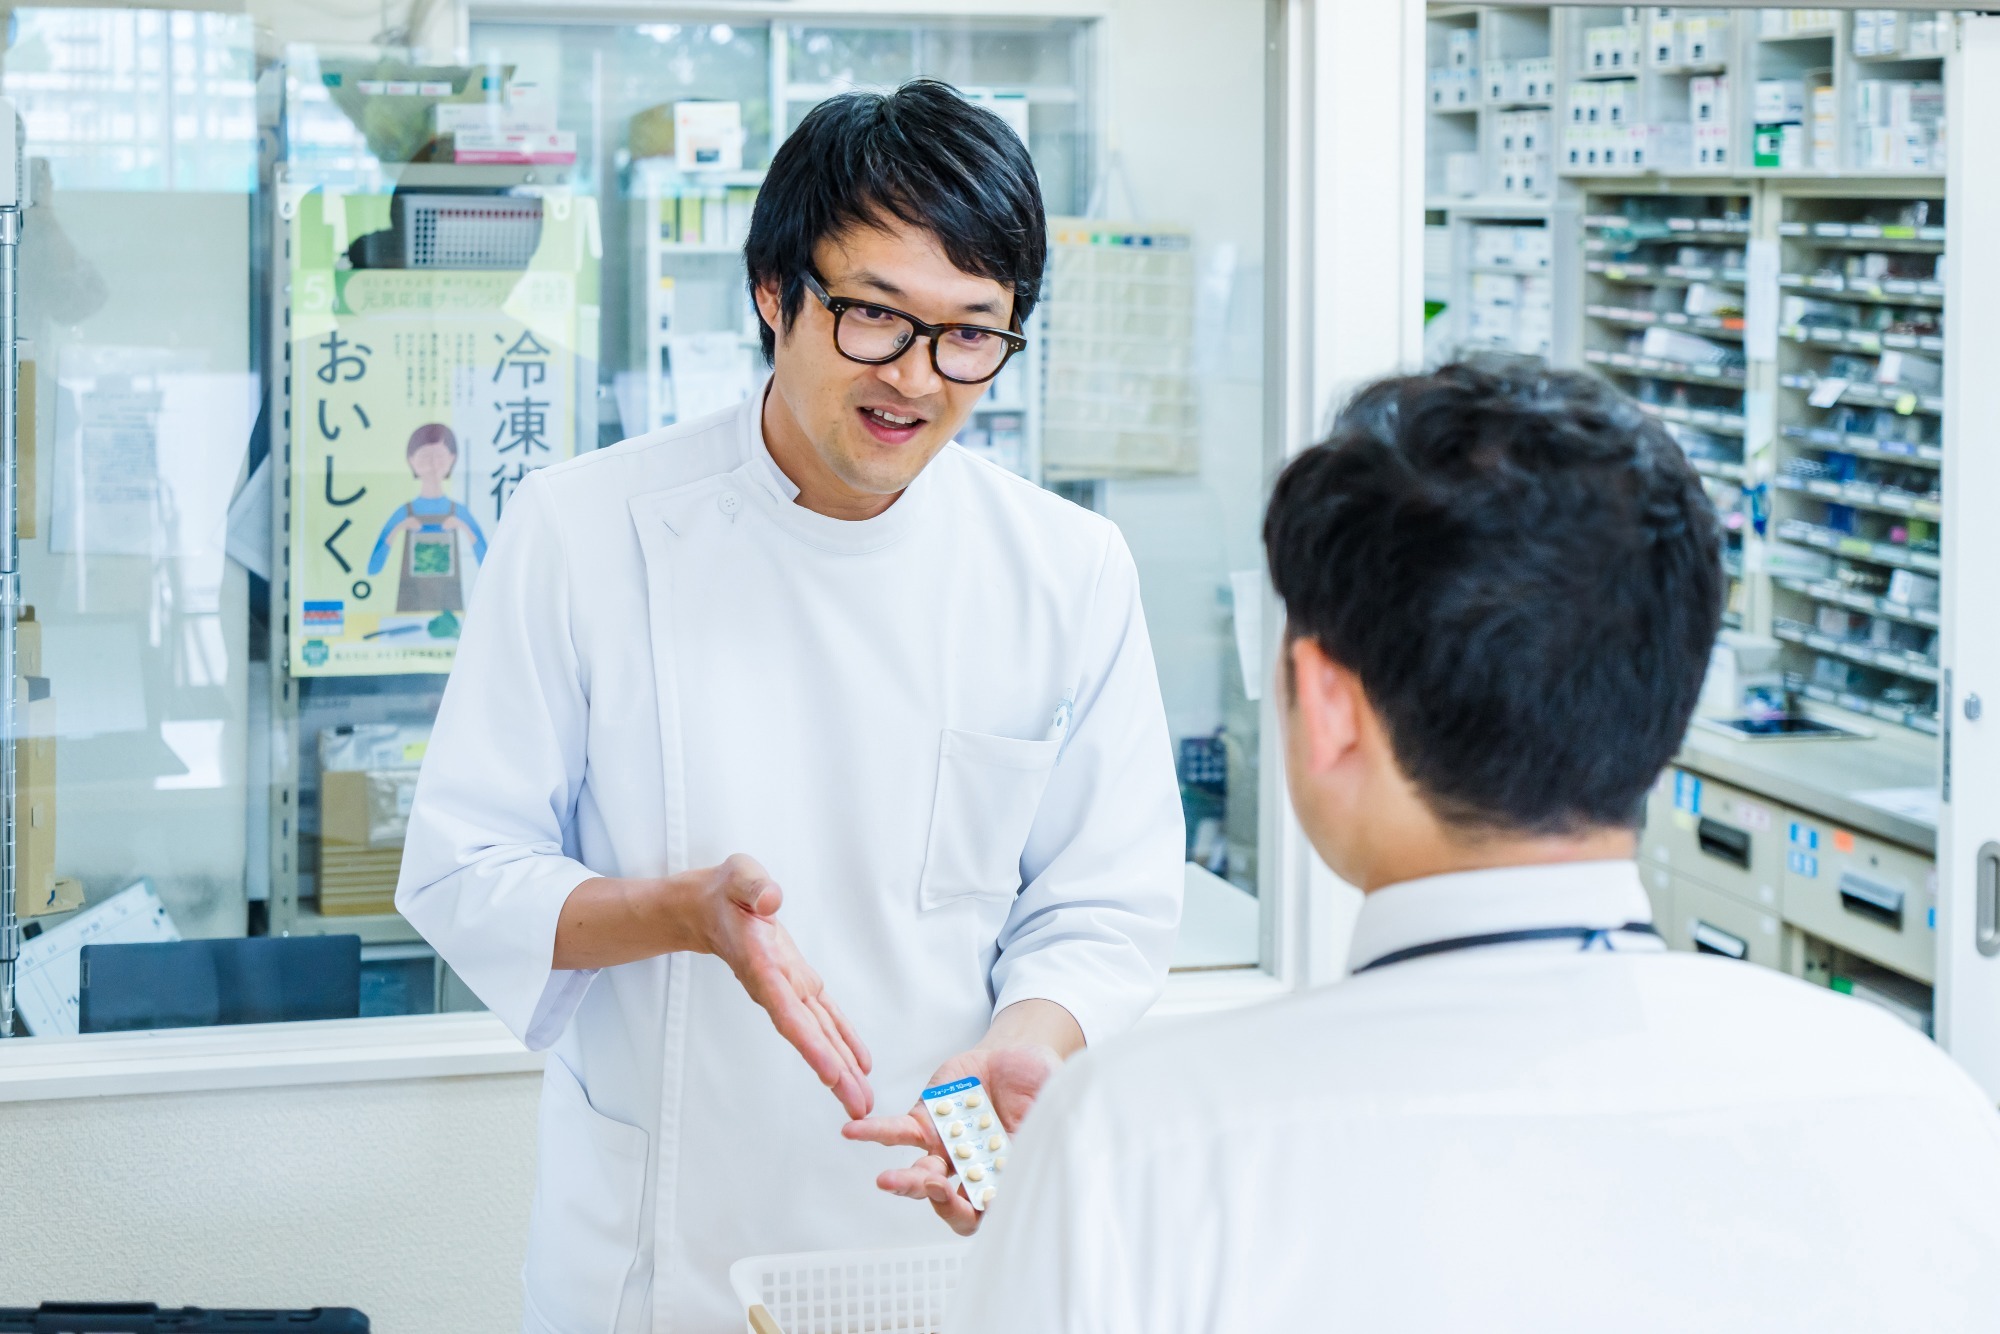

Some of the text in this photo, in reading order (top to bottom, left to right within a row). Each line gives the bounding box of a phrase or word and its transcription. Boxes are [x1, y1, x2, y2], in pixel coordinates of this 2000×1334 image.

[317, 330, 373, 600] おいしく。
[956, 1082, 972, 1090] 10mg
